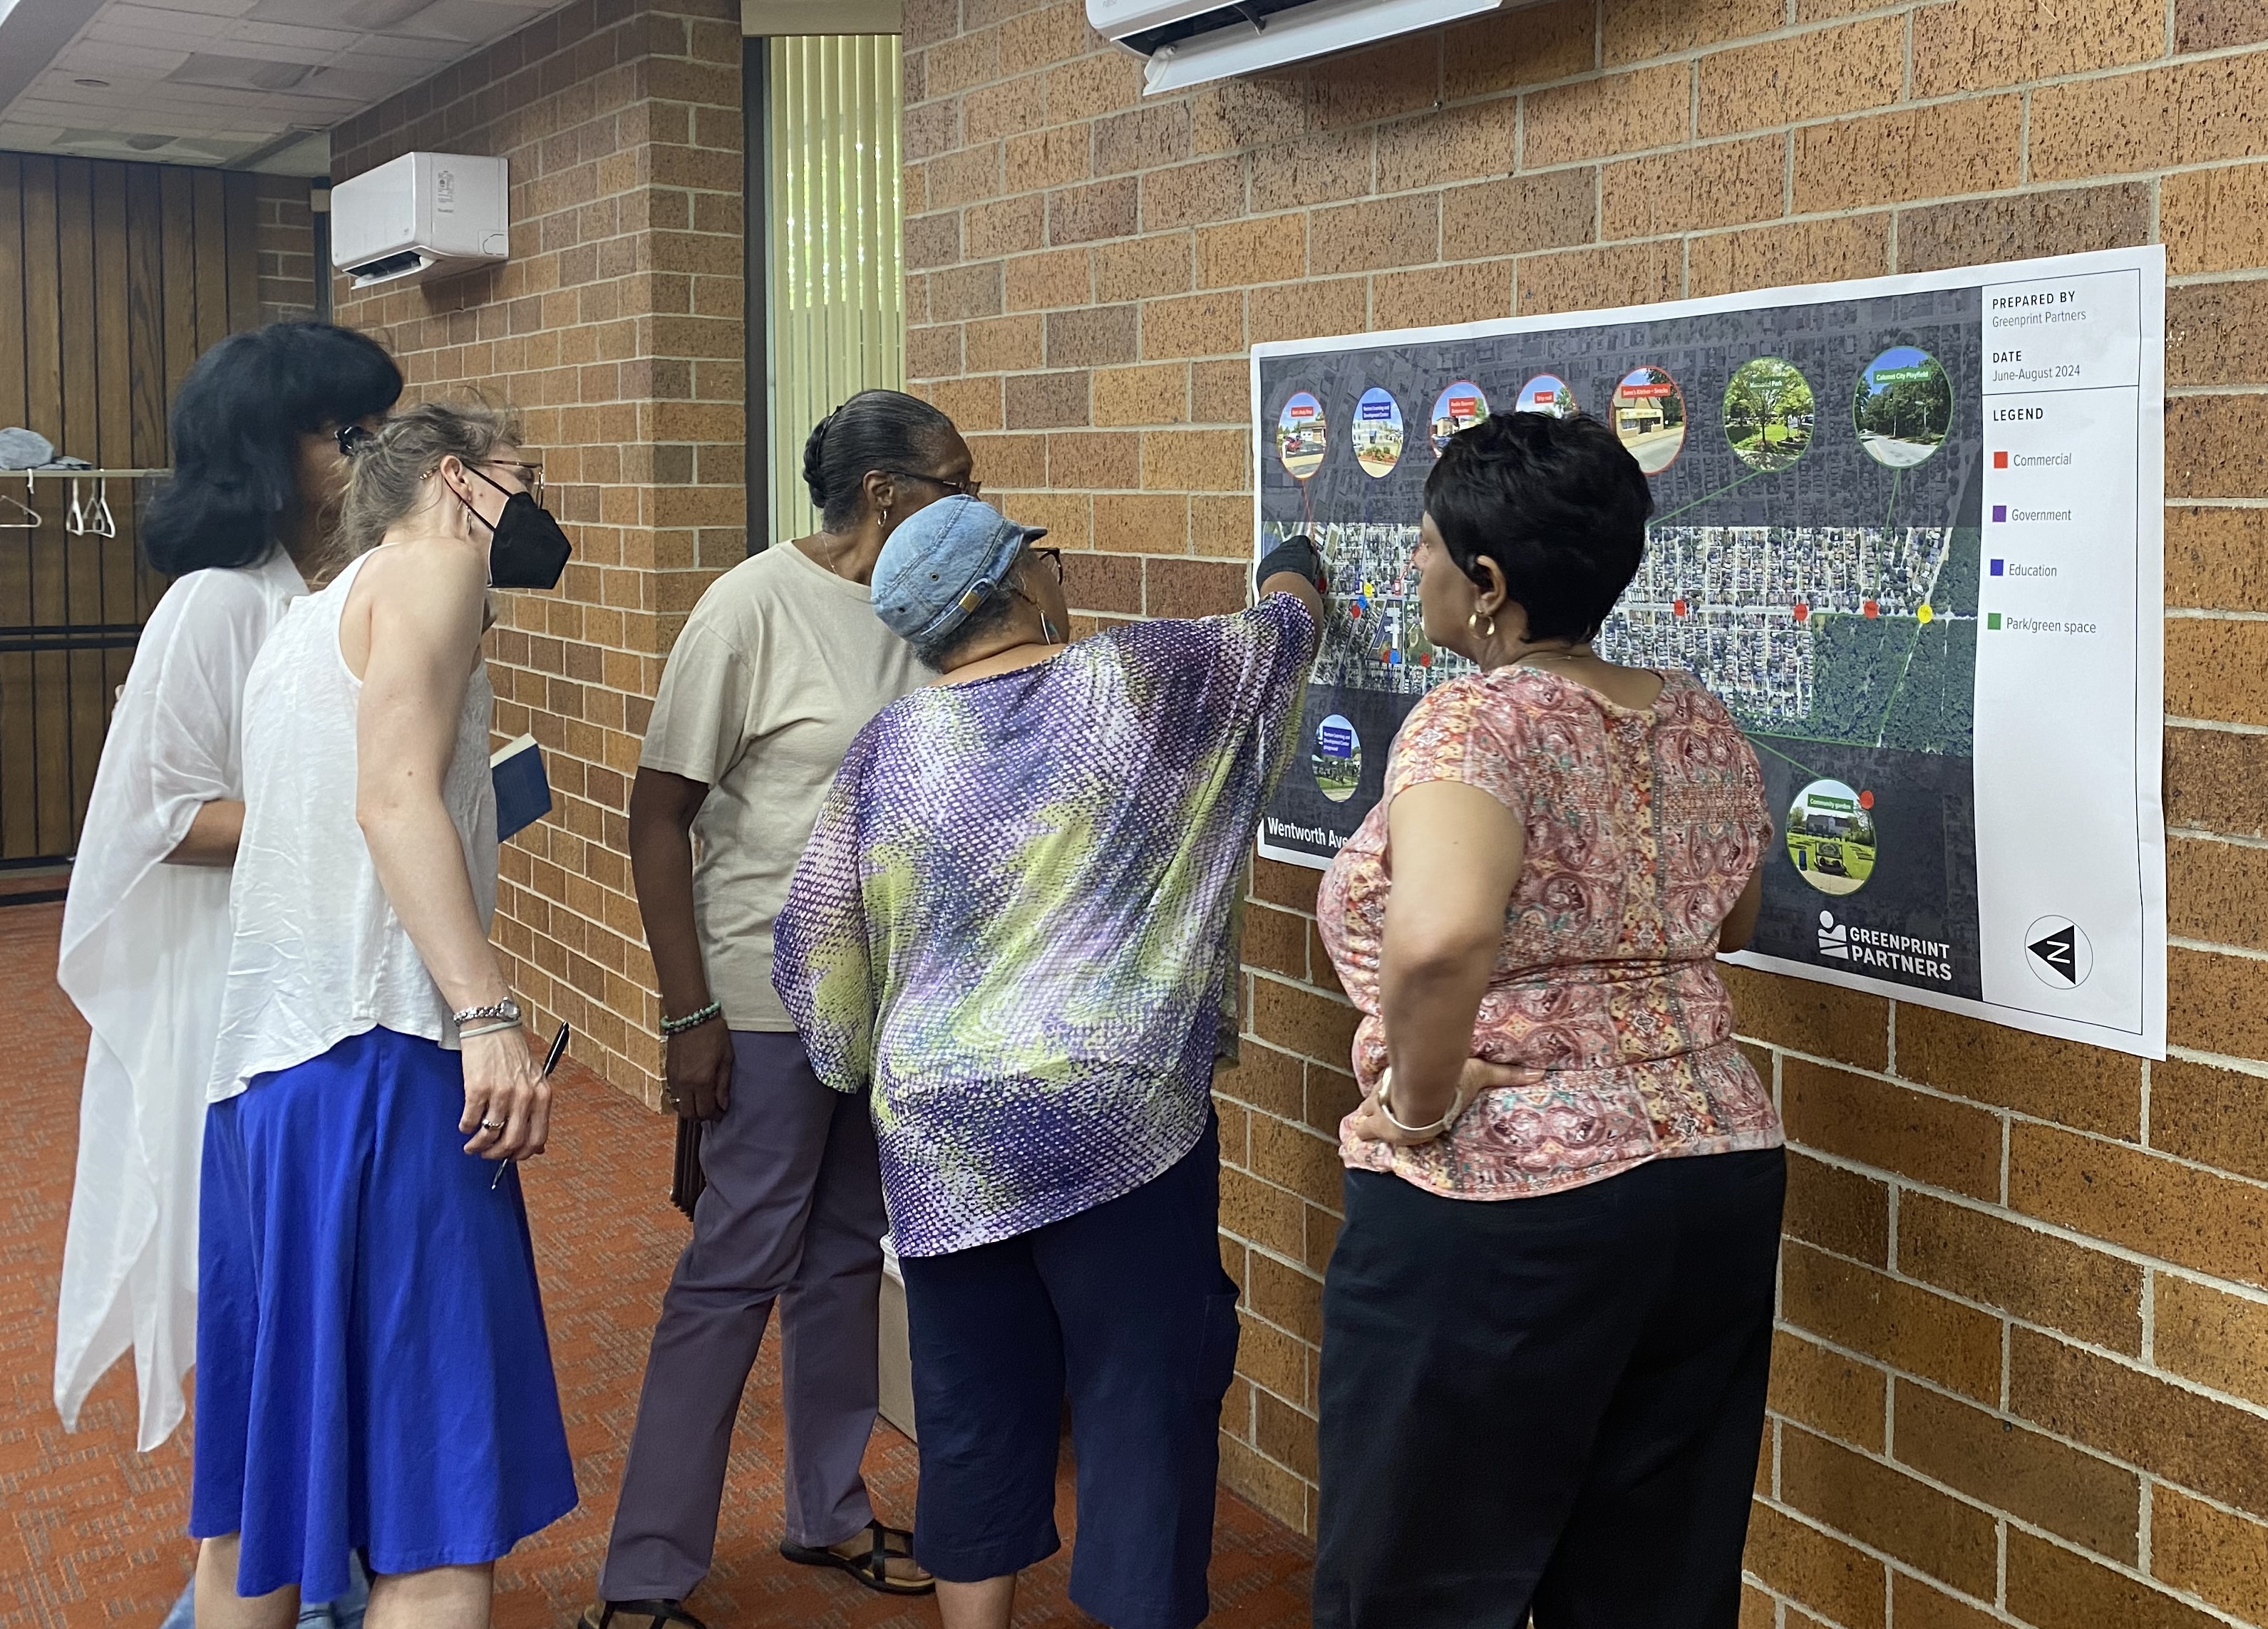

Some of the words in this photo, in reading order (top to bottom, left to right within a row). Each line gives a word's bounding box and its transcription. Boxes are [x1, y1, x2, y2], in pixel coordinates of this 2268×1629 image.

[1992, 292, 2054, 309] PREPARED
[2059, 291, 2076, 303] BY
[1992, 314, 2042, 328] Greenprint
[2045, 310, 2086, 323] Partners
[1993, 351, 2022, 363] DATE
[1992, 368, 2053, 382] June-August
[2055, 364, 2080, 378] 2024
[1994, 408, 2043, 421] LEGEND
[2014, 453, 2072, 466] Commercial
[2011, 509, 2071, 522] Government
[2009, 564, 2057, 576] Education
[2006, 617, 2061, 633] Park/green
[2064, 621, 2096, 635] space
[1267, 817, 1326, 846] Wentworth
[1850, 927, 1949, 959] GREENPRINT
[1852, 945, 1952, 981] PARTNERS
